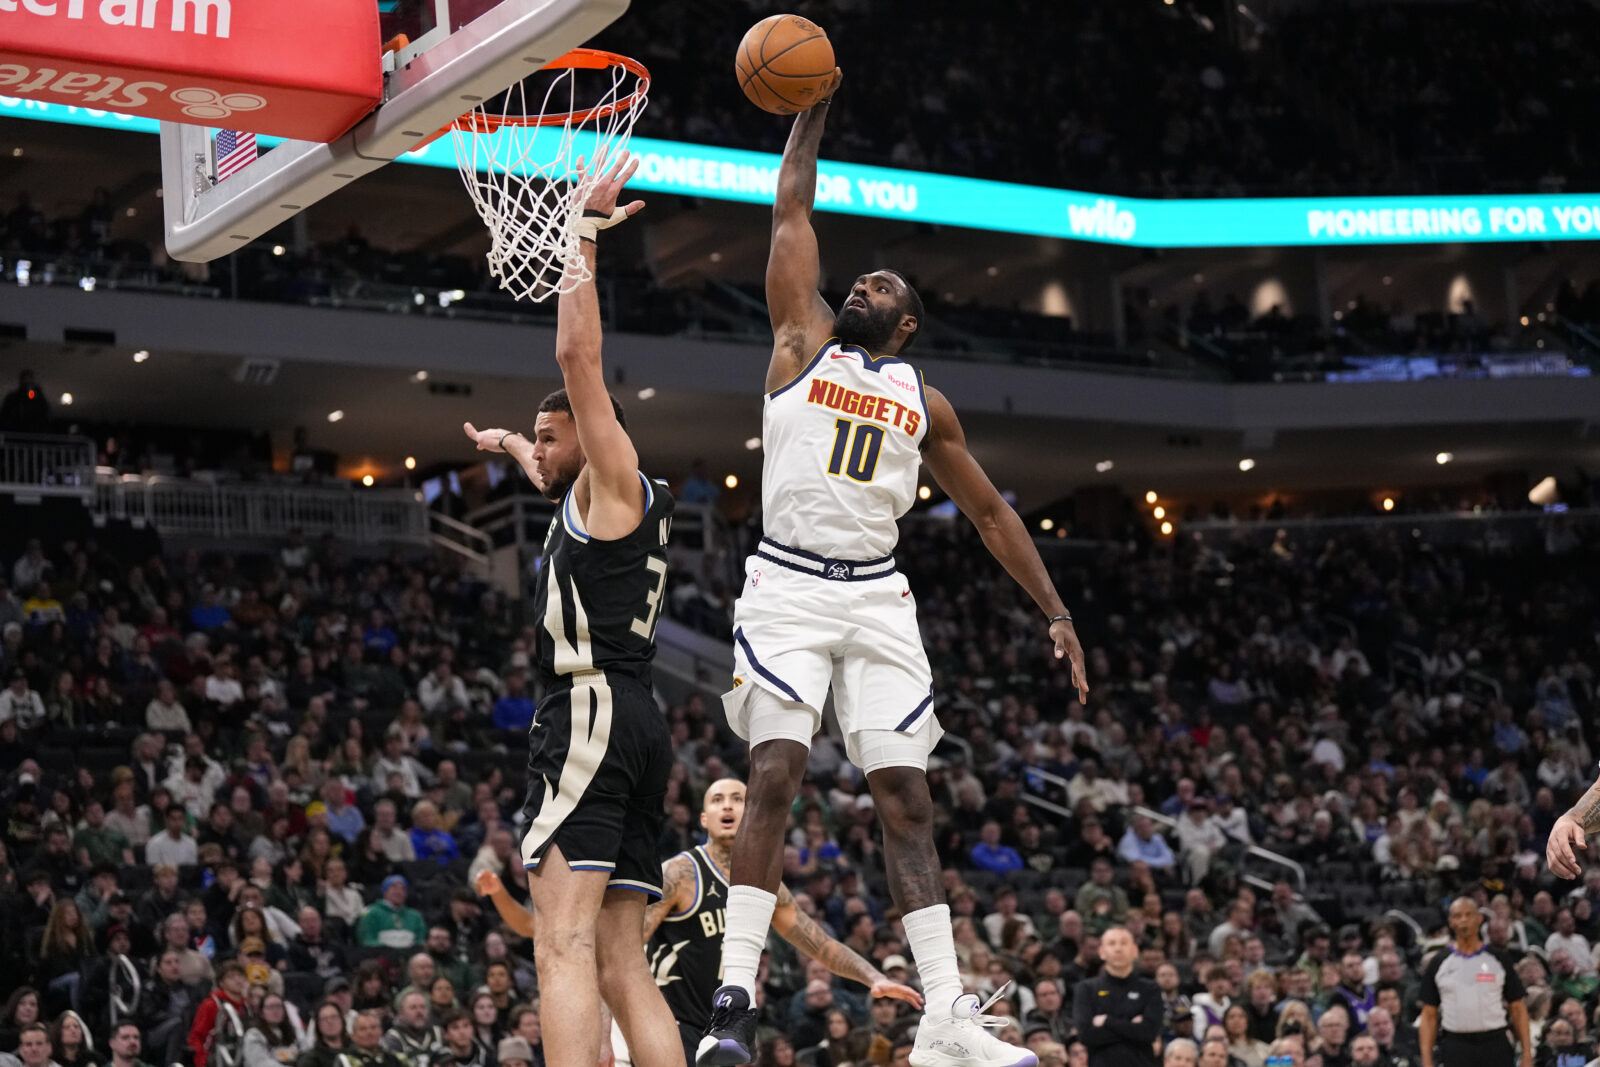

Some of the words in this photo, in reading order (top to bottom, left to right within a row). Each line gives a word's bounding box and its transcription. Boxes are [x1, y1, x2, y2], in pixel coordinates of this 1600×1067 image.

[0, 63, 168, 108] State
[816, 173, 854, 205] OR
[857, 178, 919, 213] YOU
[1067, 197, 1137, 233] wilo
[1307, 206, 1482, 237] PIONEERING
[1489, 206, 1547, 234] FOR
[807, 378, 922, 437] NUGGETS
[826, 417, 886, 483] 10
